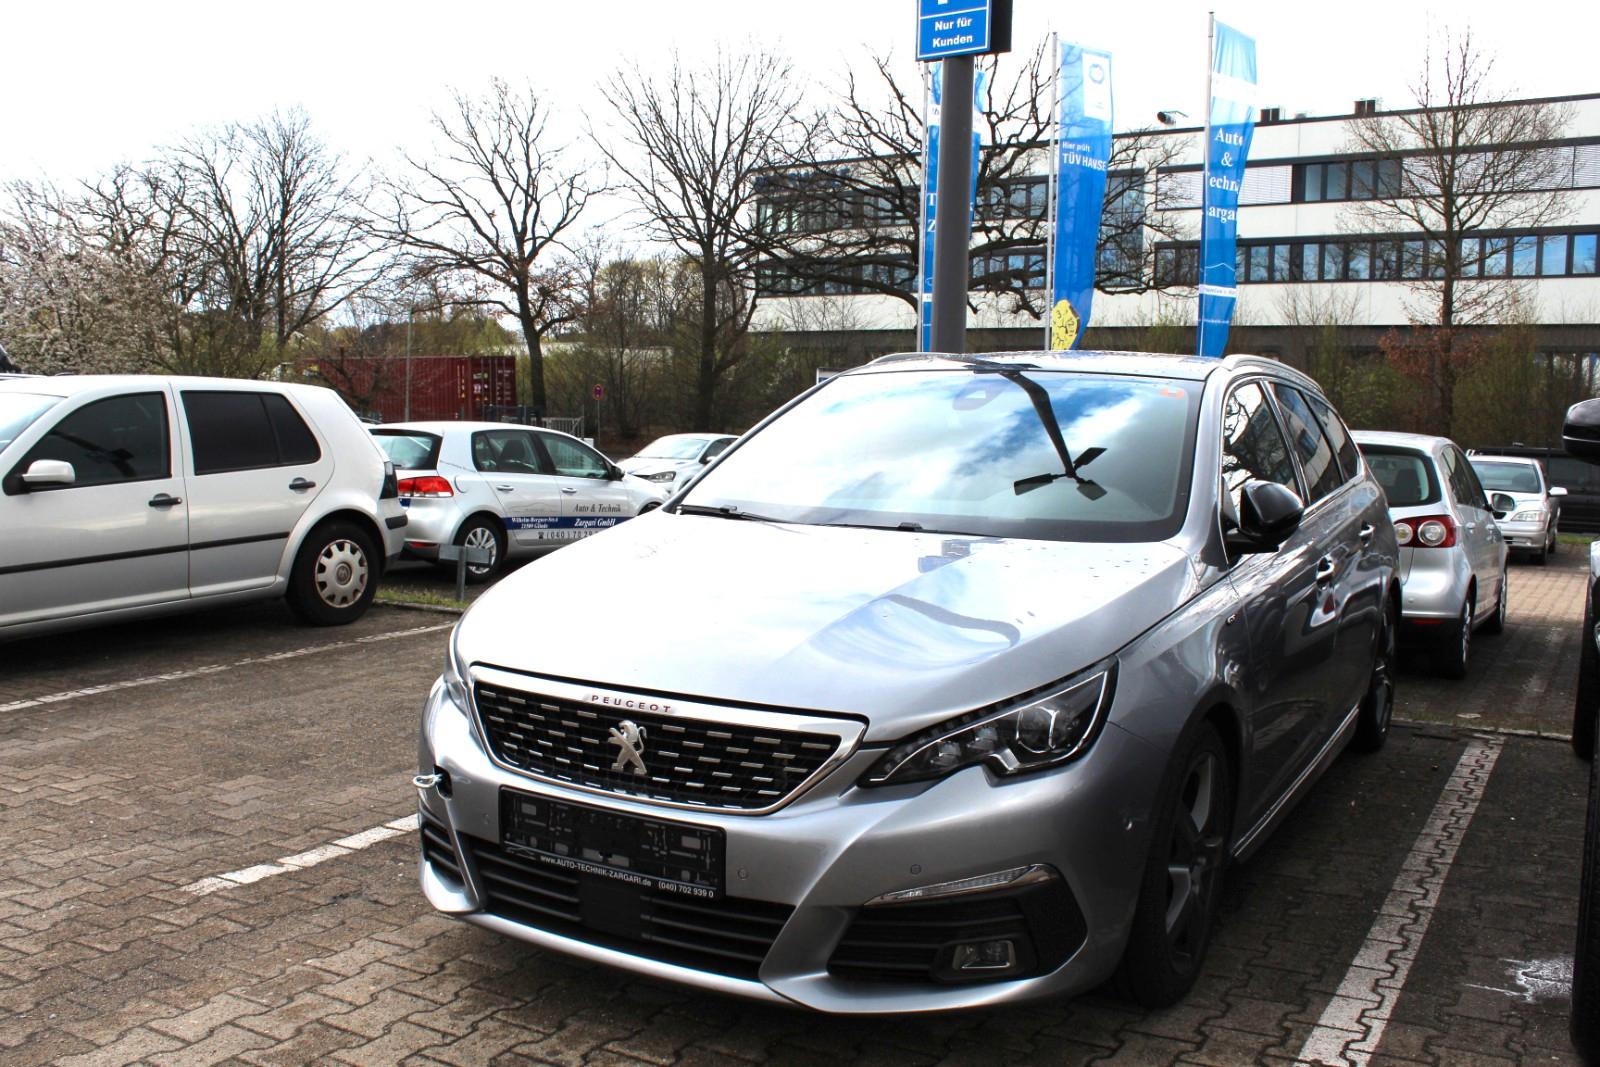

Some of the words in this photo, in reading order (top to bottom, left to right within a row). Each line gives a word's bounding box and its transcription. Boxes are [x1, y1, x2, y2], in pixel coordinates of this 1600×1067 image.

[934, 20, 954, 31] Nur
[956, 17, 973, 28] für
[932, 35, 973, 48] Kunden
[1062, 152, 1081, 165] TÜV
[1220, 151, 1233, 167] &
[574, 504, 589, 513] Auto
[598, 503, 622, 513] Technik
[591, 694, 671, 713] PEUGEOT
[679, 884, 691, 895] 702
[693, 887, 707, 897] 939
